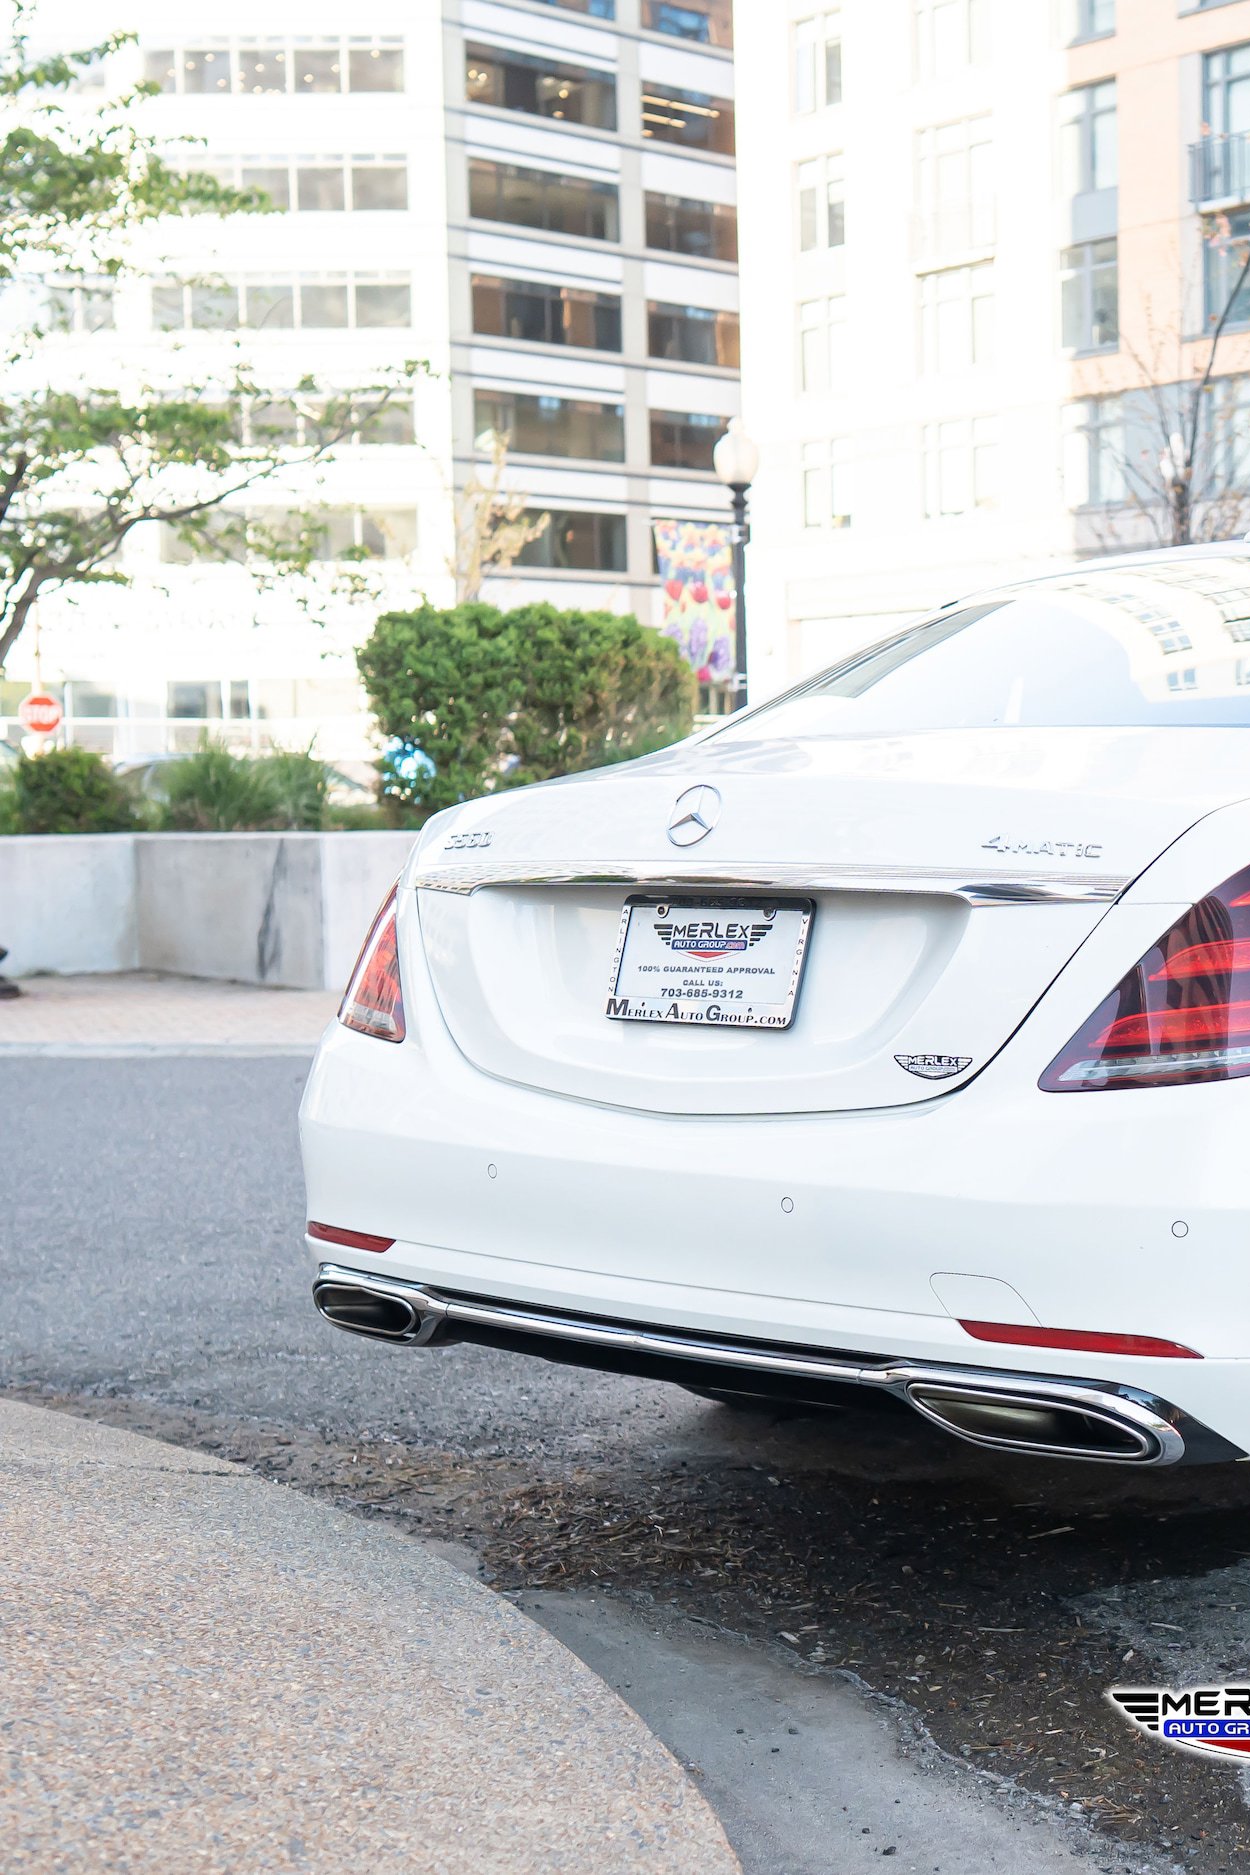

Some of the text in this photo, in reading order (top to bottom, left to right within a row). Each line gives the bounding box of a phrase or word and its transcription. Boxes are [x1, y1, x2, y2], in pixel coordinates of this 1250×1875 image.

[980, 834, 1104, 858] 4MATIC
[672, 922, 750, 939] MERLEX
[674, 940, 696, 949] AUTO
[638, 965, 776, 975] 100% GUARANTEED APPROVAL
[683, 979, 705, 987] CALL
[661, 988, 744, 999] 703-685-9312
[908, 1055, 958, 1066] MERLEX
